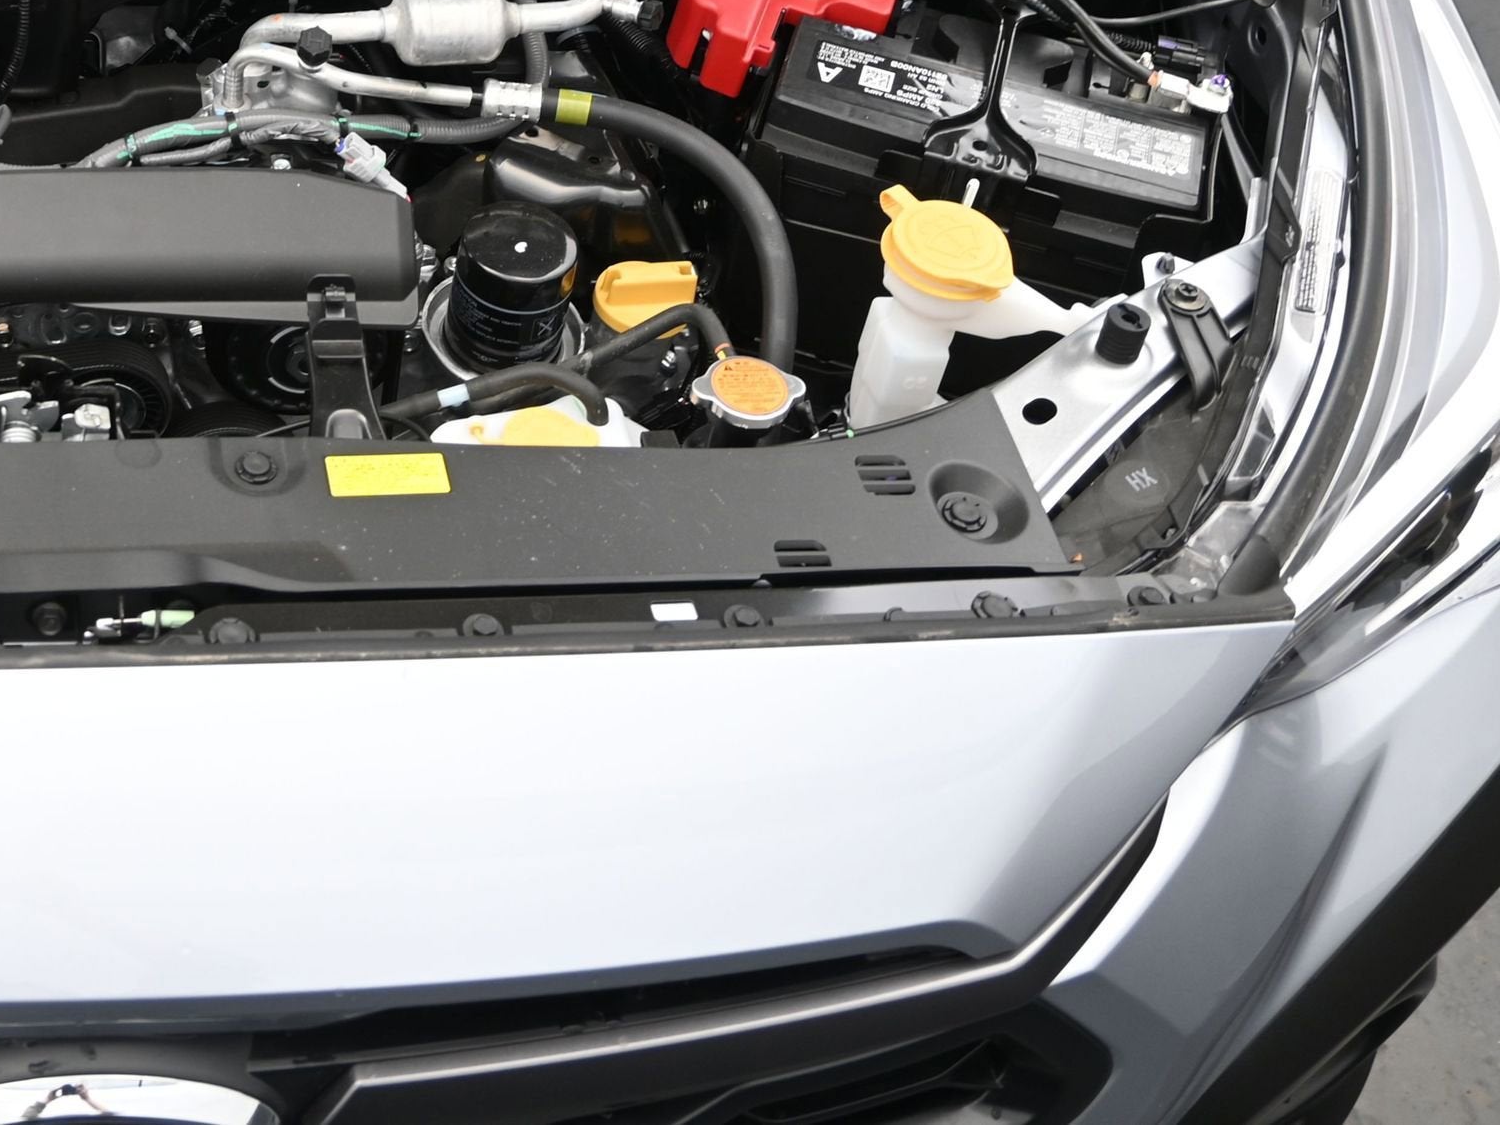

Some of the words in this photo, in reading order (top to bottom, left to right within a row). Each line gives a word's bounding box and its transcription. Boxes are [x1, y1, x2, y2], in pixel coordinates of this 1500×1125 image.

[864, 87, 884, 97] AMPS
[896, 89, 924, 101] AMPS
[1124, 467, 1158, 492] HX
